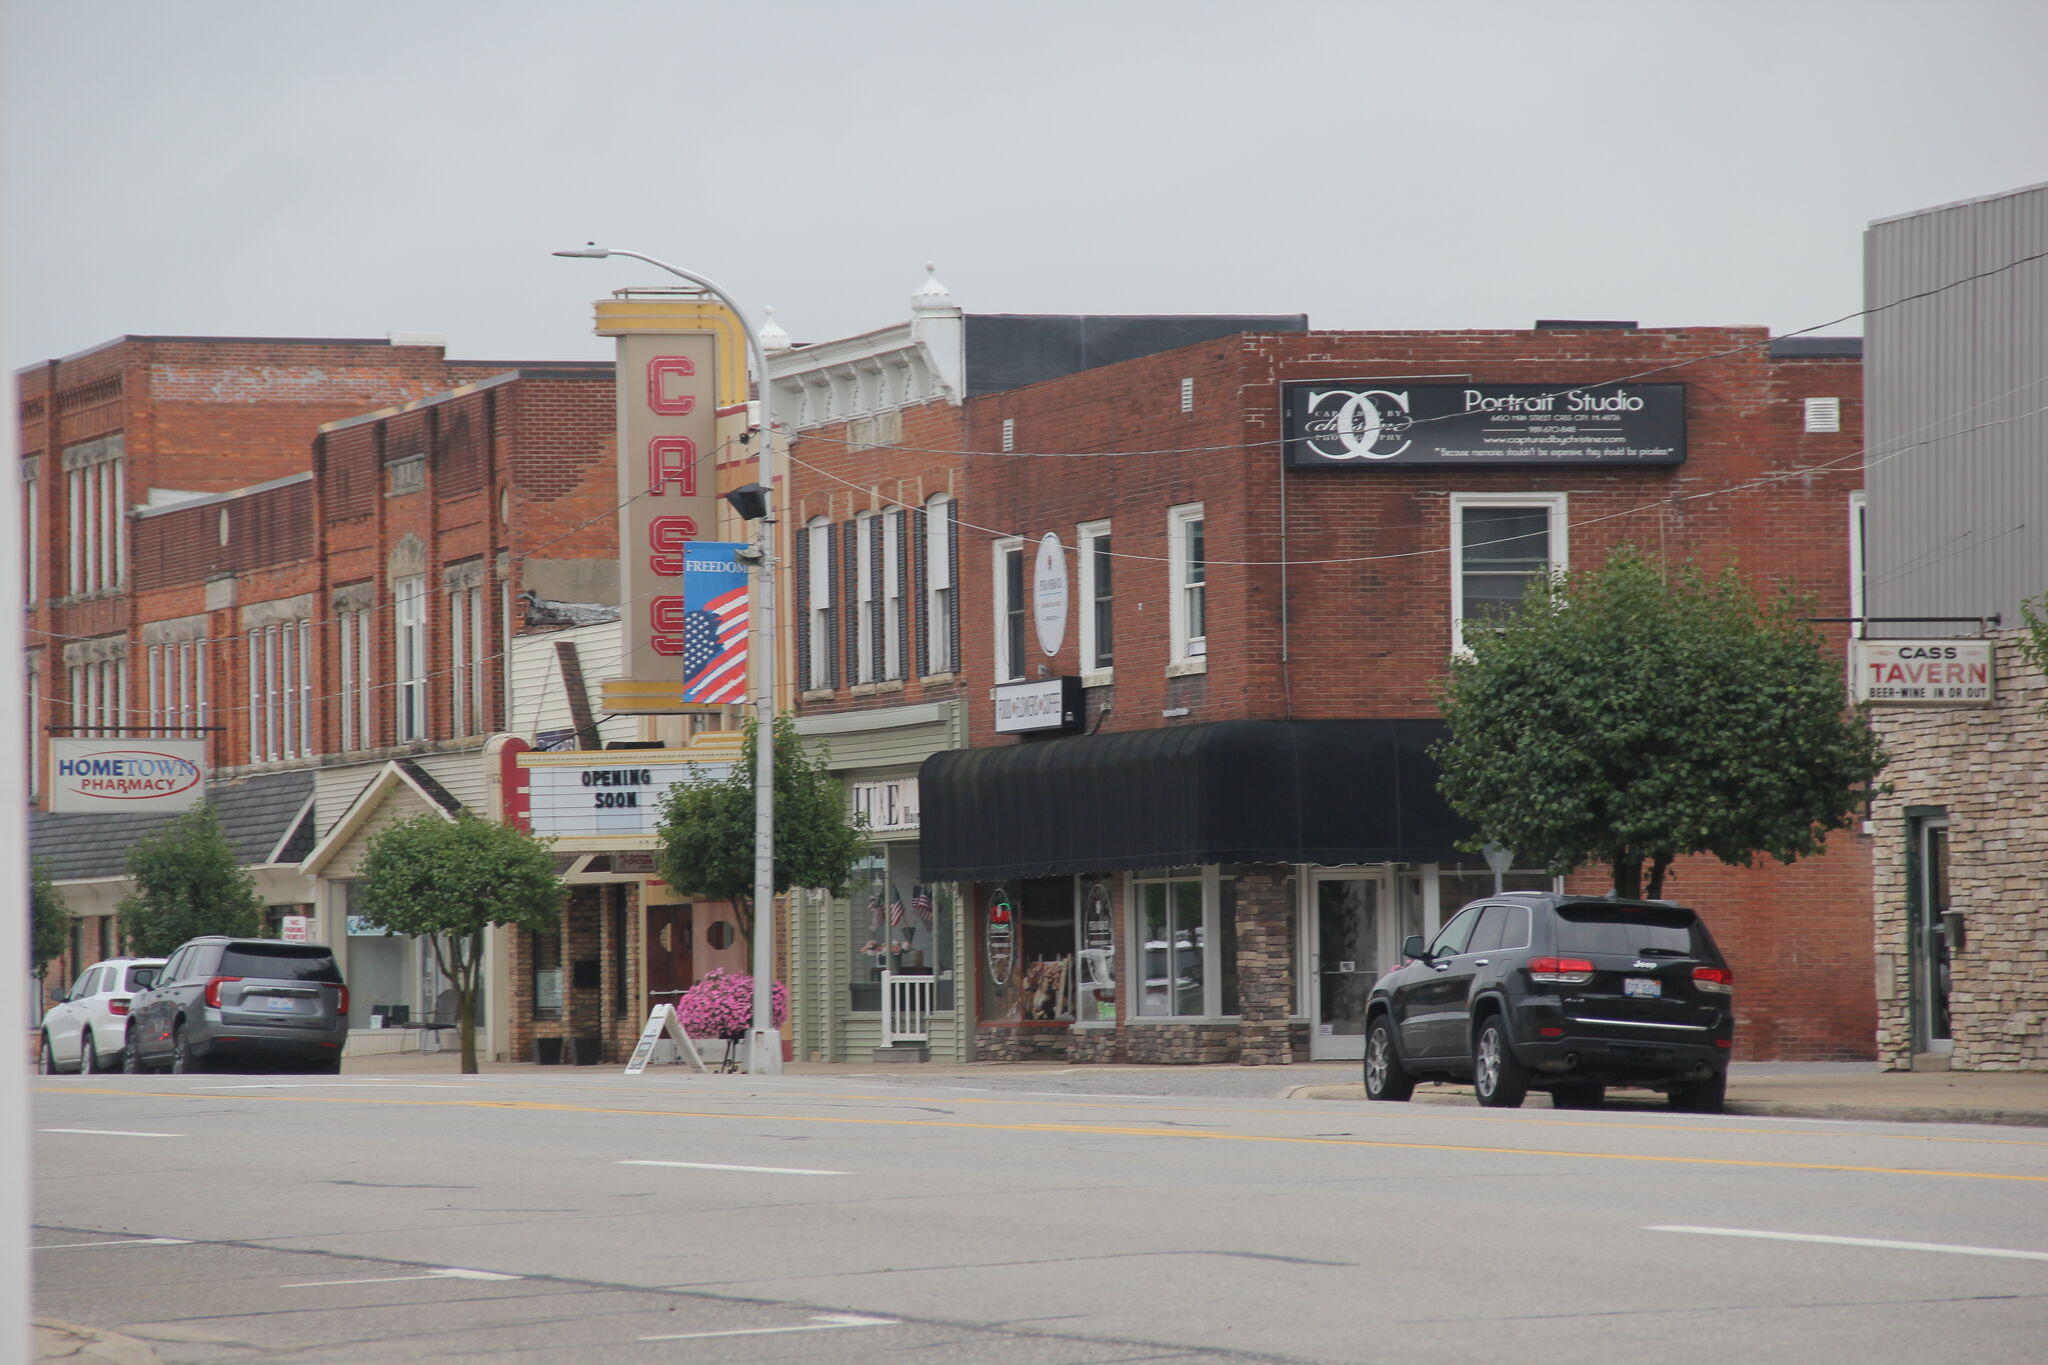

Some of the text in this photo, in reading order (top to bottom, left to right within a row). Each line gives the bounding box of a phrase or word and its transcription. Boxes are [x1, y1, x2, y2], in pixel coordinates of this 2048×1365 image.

[1464, 389, 1644, 412] Portrait Studio
[647, 355, 698, 656] CASS
[685, 560, 748, 574] FREEDOM
[1898, 647, 1957, 659] CASS
[1869, 663, 1987, 683] TAVERN
[1869, 687, 1987, 698] BEER-WINE IN OR OUT
[59, 759, 196, 777] HOMETOWN
[81, 779, 176, 793] PHARMACY
[582, 769, 651, 787] OPENING
[594, 792, 637, 809] SOON
[1633, 960, 1657, 969] Jeep
